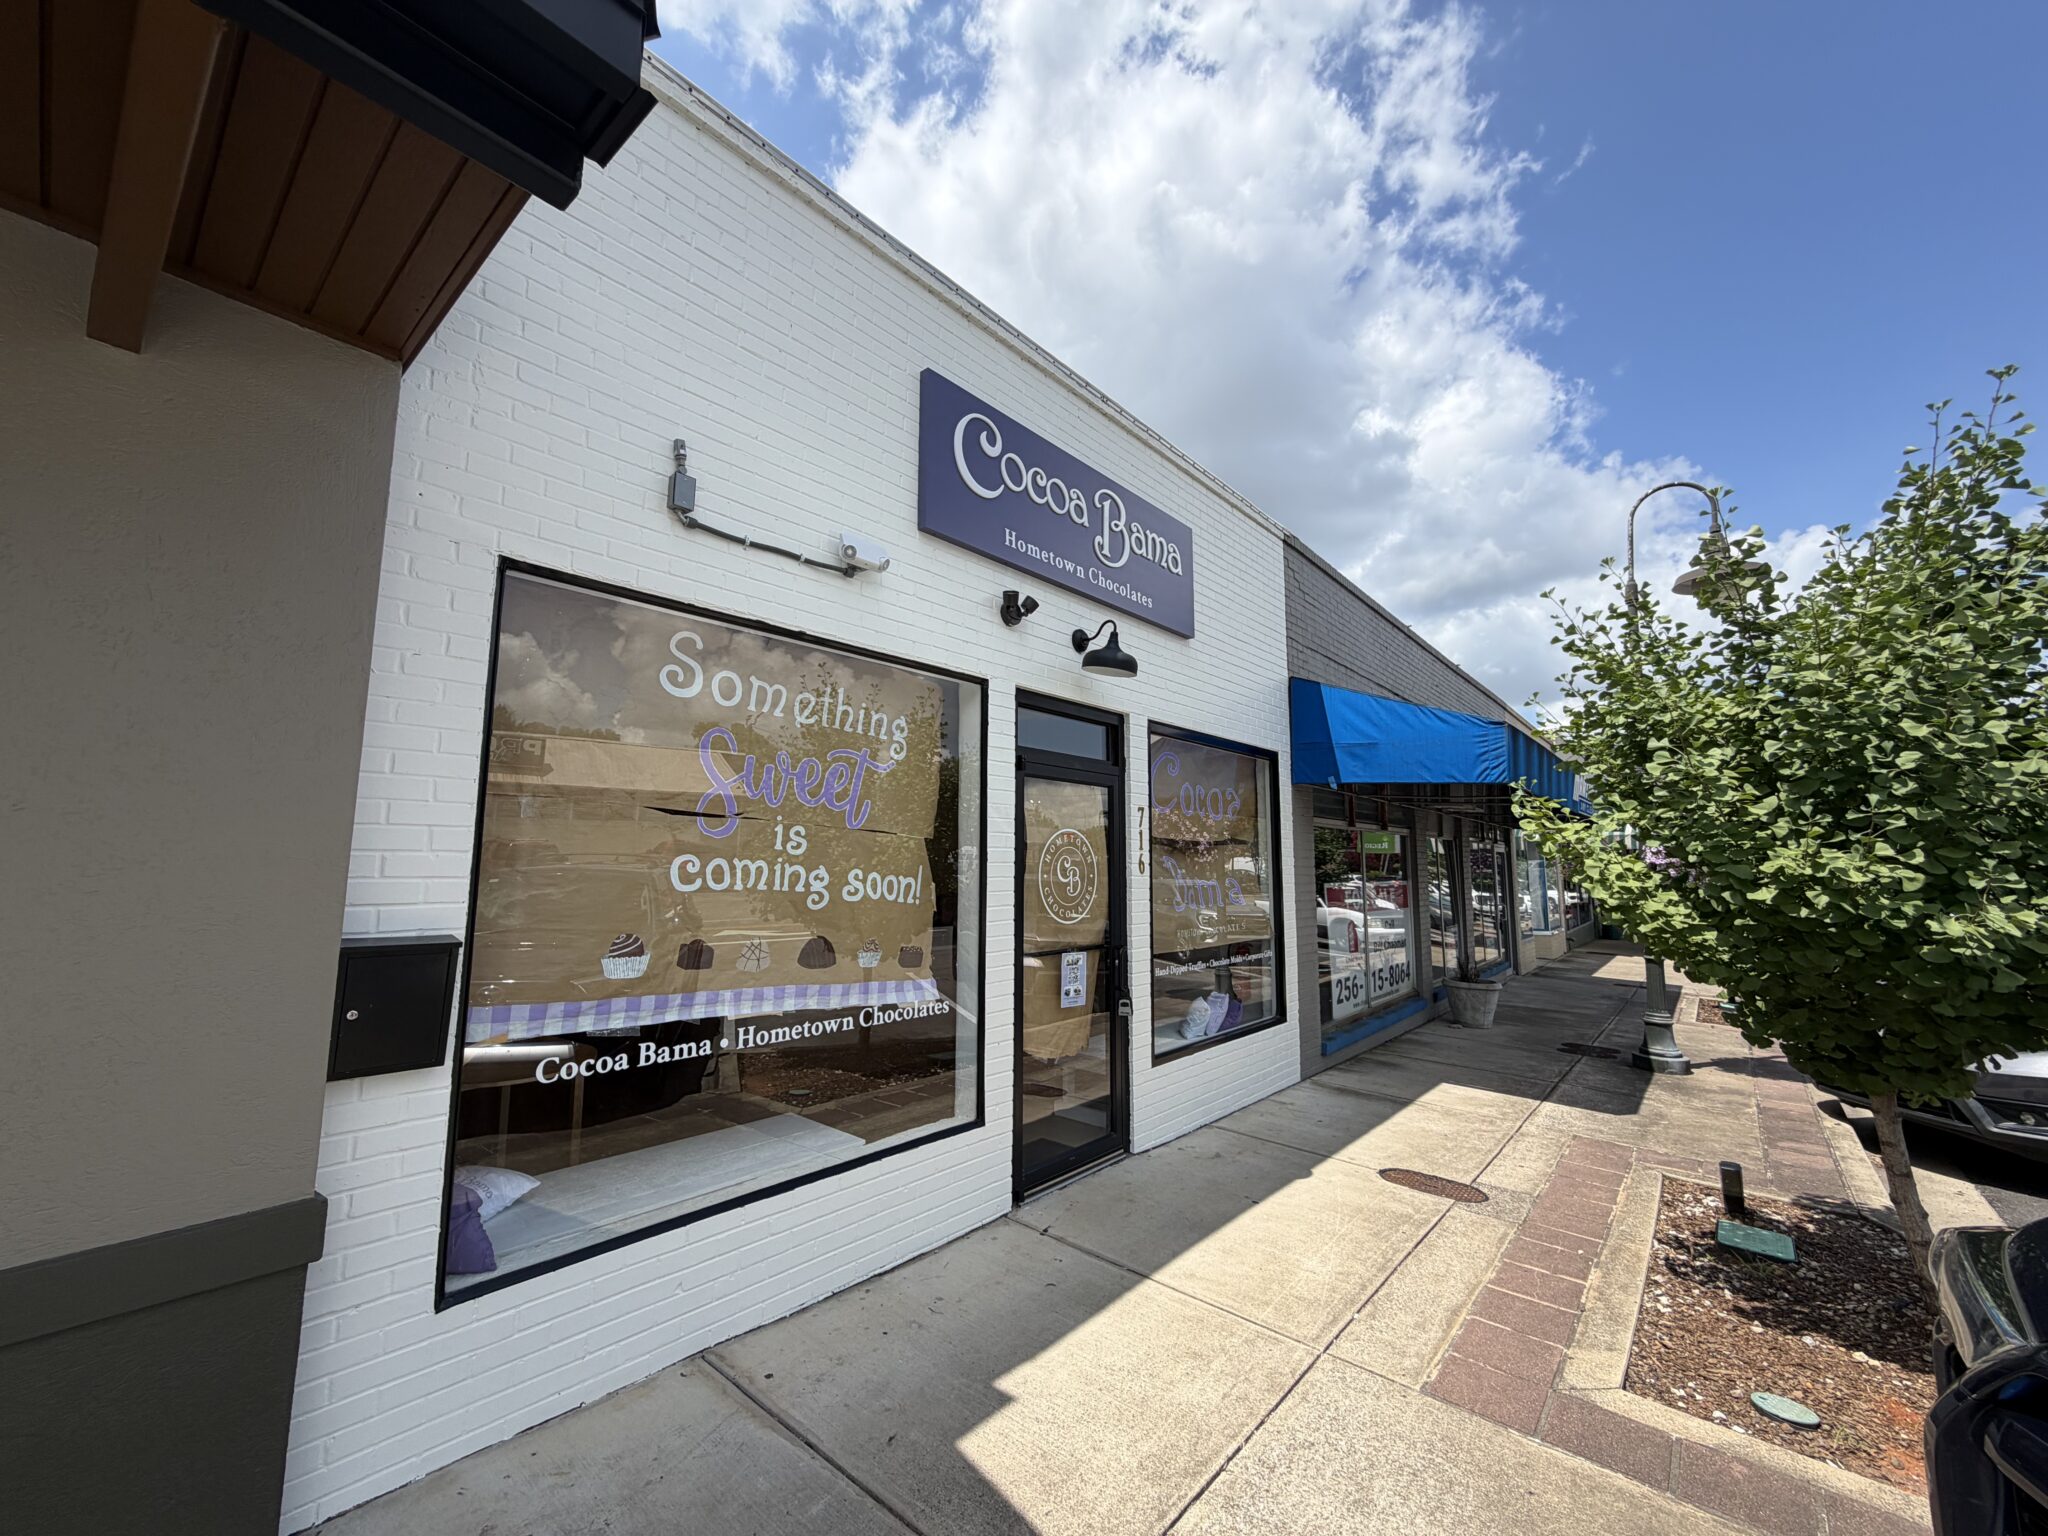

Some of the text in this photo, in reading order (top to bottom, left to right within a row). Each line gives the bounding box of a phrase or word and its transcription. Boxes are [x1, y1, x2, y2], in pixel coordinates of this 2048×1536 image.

[954, 412, 1183, 576] Cocoa Bama
[1004, 528, 1153, 609] Hometown Chocolates
[659, 630, 909, 761] Something
[696, 727, 896, 839] Sweet
[1151, 752, 1243, 820] Cocoa
[774, 815, 808, 856] is
[1045, 834, 1092, 863] HOMETOWN
[1137, 807, 1146, 875] 716
[1044, 886, 1093, 918] CHOCOLATES
[1336, 960, 1411, 1005] 256-15-8064
[535, 998, 950, 1085] Cocoa Bama Hometown Chocolates
